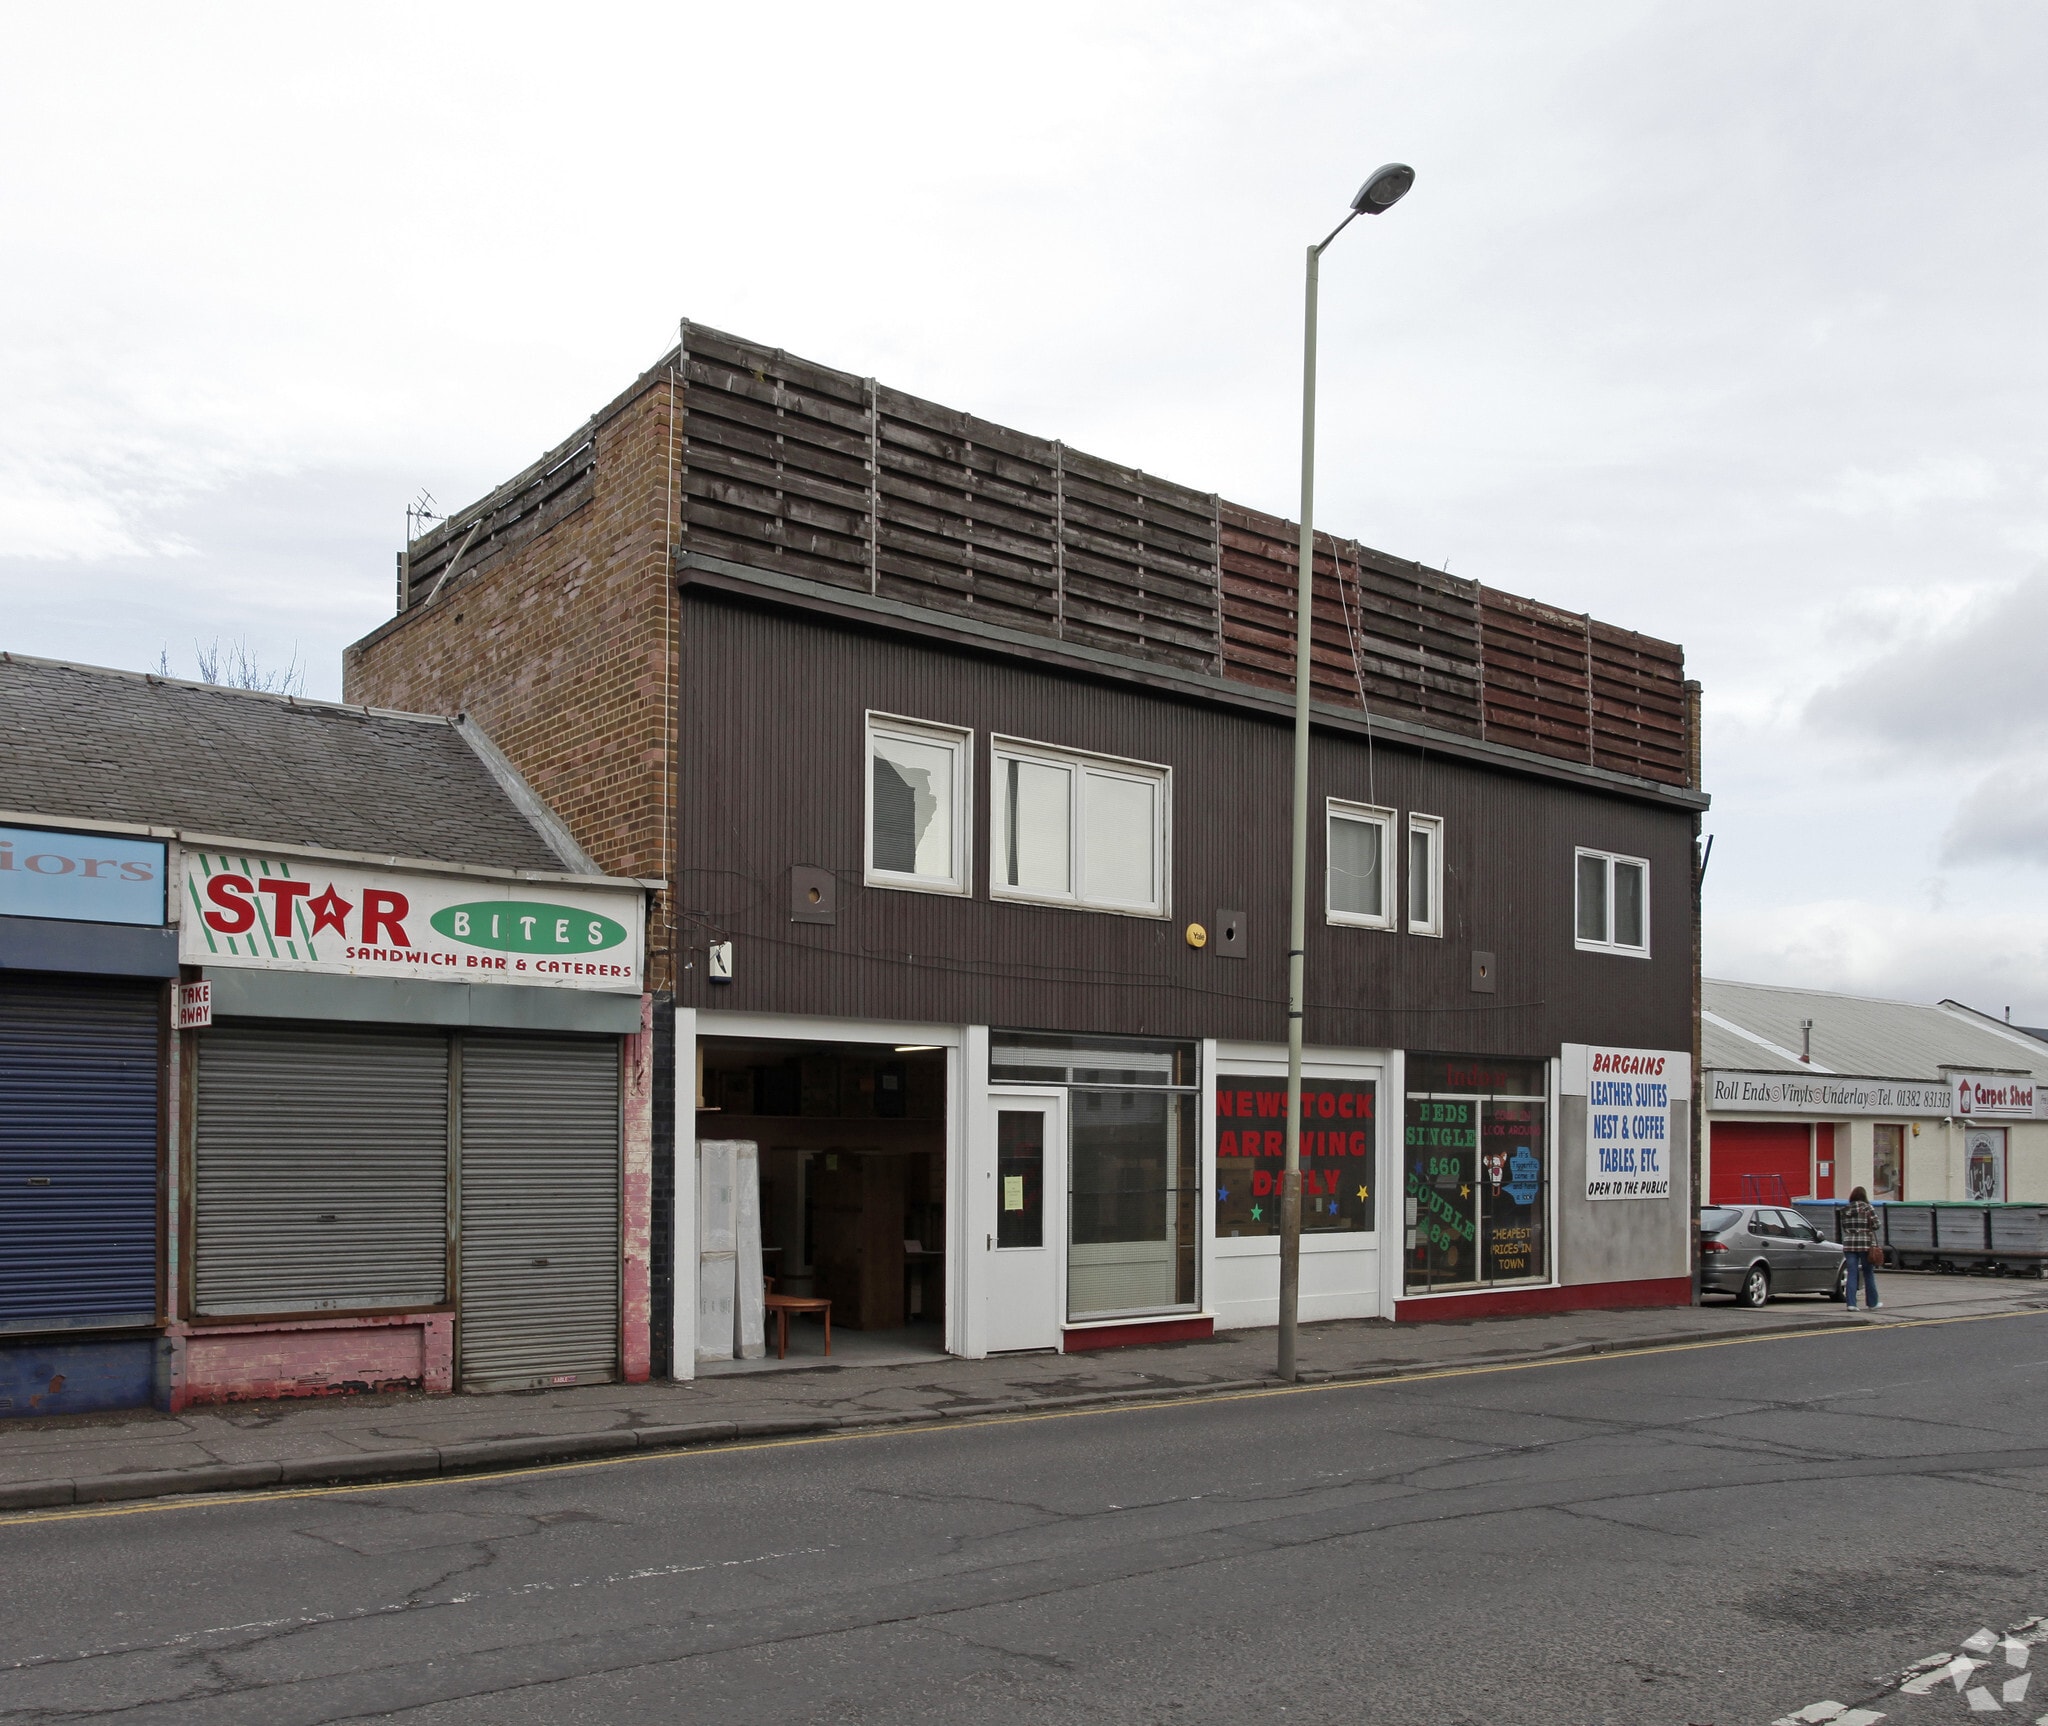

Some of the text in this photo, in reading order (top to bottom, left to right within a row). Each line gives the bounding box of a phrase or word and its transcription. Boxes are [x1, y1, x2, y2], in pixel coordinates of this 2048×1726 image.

[0, 841, 154, 881] iors
[204, 874, 412, 948] STAR
[454, 911, 603, 945] BITES
[1193, 931, 1206, 941] Yale
[346, 946, 632, 978] SANDWICH BAR & CATERERS
[181, 985, 209, 1004] TAKE
[180, 1005, 209, 1025] AWAY
[1592, 1053, 1666, 1076] BARGAINS
[1591, 1081, 1667, 1108] LEATHER SUITES
[1715, 1080, 1950, 1109] Roll Ends Vinyls Underlay Tel. 01382 831313
[1975, 1083, 2007, 1109] Carpet
[2010, 1085, 2033, 1106] Shed
[1420, 1103, 1467, 1123] BEDS
[1406, 1126, 1476, 1147] SINGLE
[1593, 1115, 1665, 1139] NEST & COFFEE
[1218, 1130, 1366, 1157] ARRVING
[1429, 1156, 1460, 1175] £60
[1599, 1148, 1659, 1177] TABLES, ETC.
[1588, 1180, 1668, 1196] OPEN TO THE PUBLIC
[1406, 1172, 1475, 1241] DOUBLE
[1520, 1243, 1532, 1253] IN
[1498, 1258, 1525, 1270] TOWN
